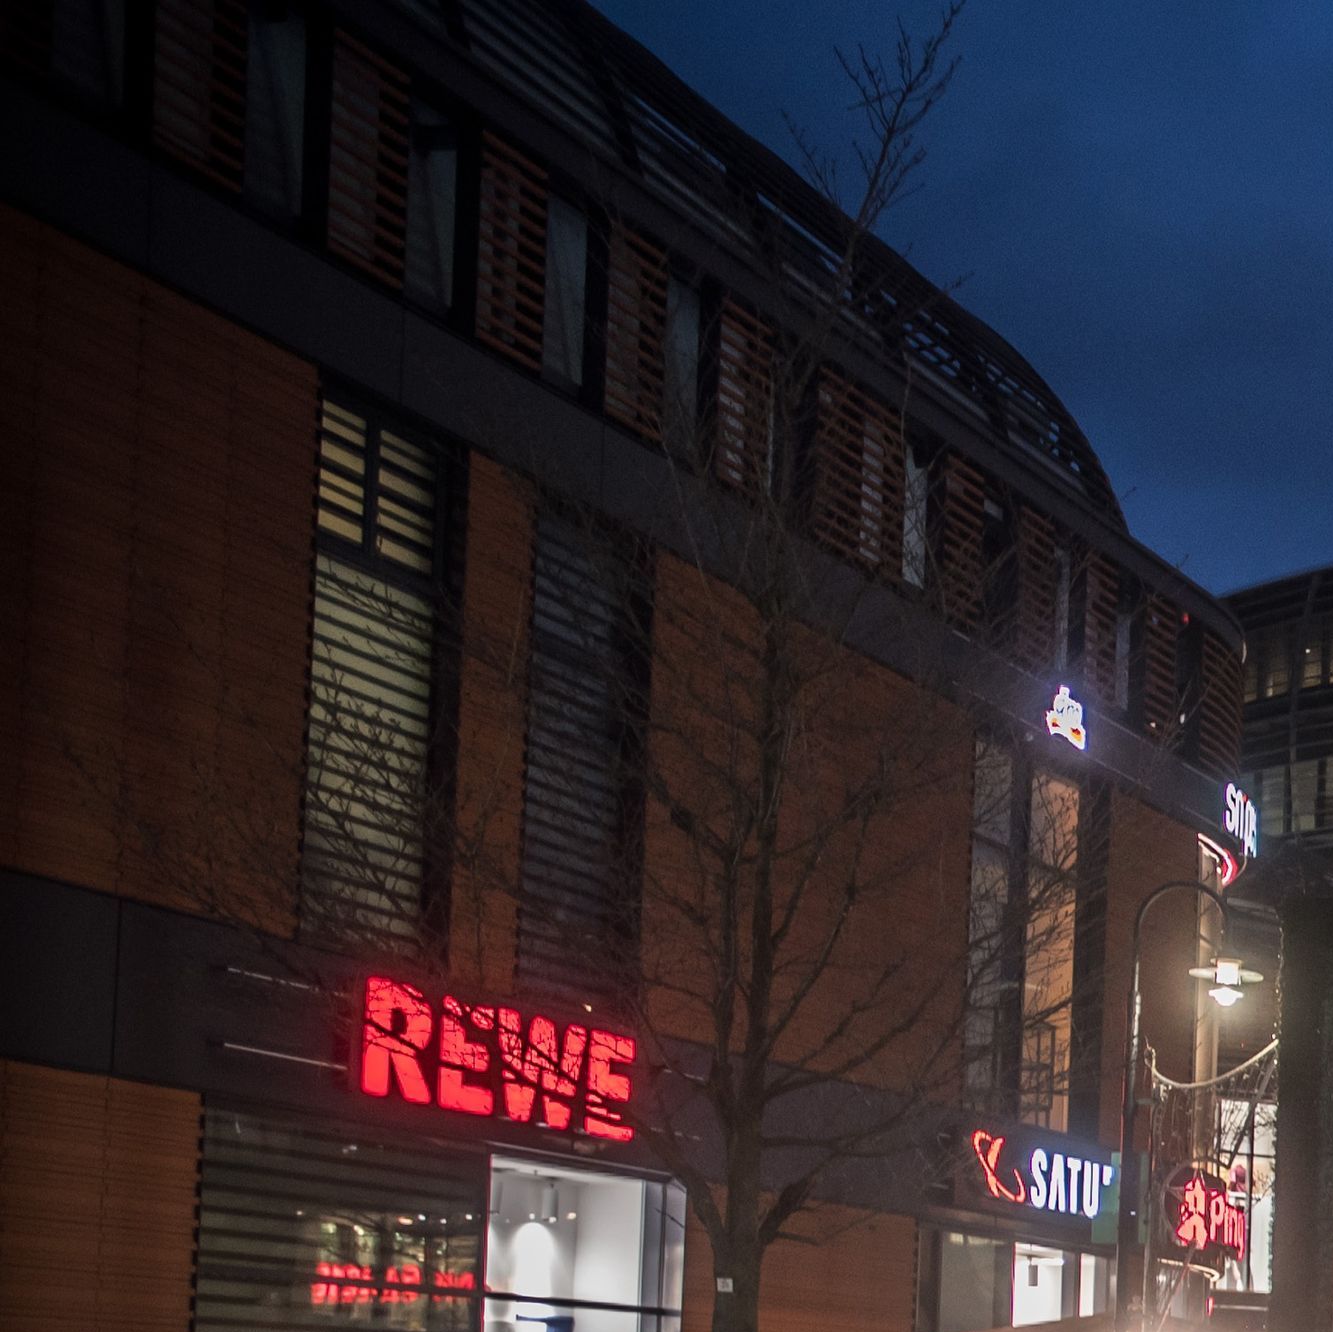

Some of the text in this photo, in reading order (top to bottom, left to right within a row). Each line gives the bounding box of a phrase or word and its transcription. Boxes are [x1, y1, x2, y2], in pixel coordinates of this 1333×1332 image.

[361, 976, 636, 1142] REWE
[1030, 1148, 1113, 1219] SATU
[1209, 1193, 1245, 1261] Ping
